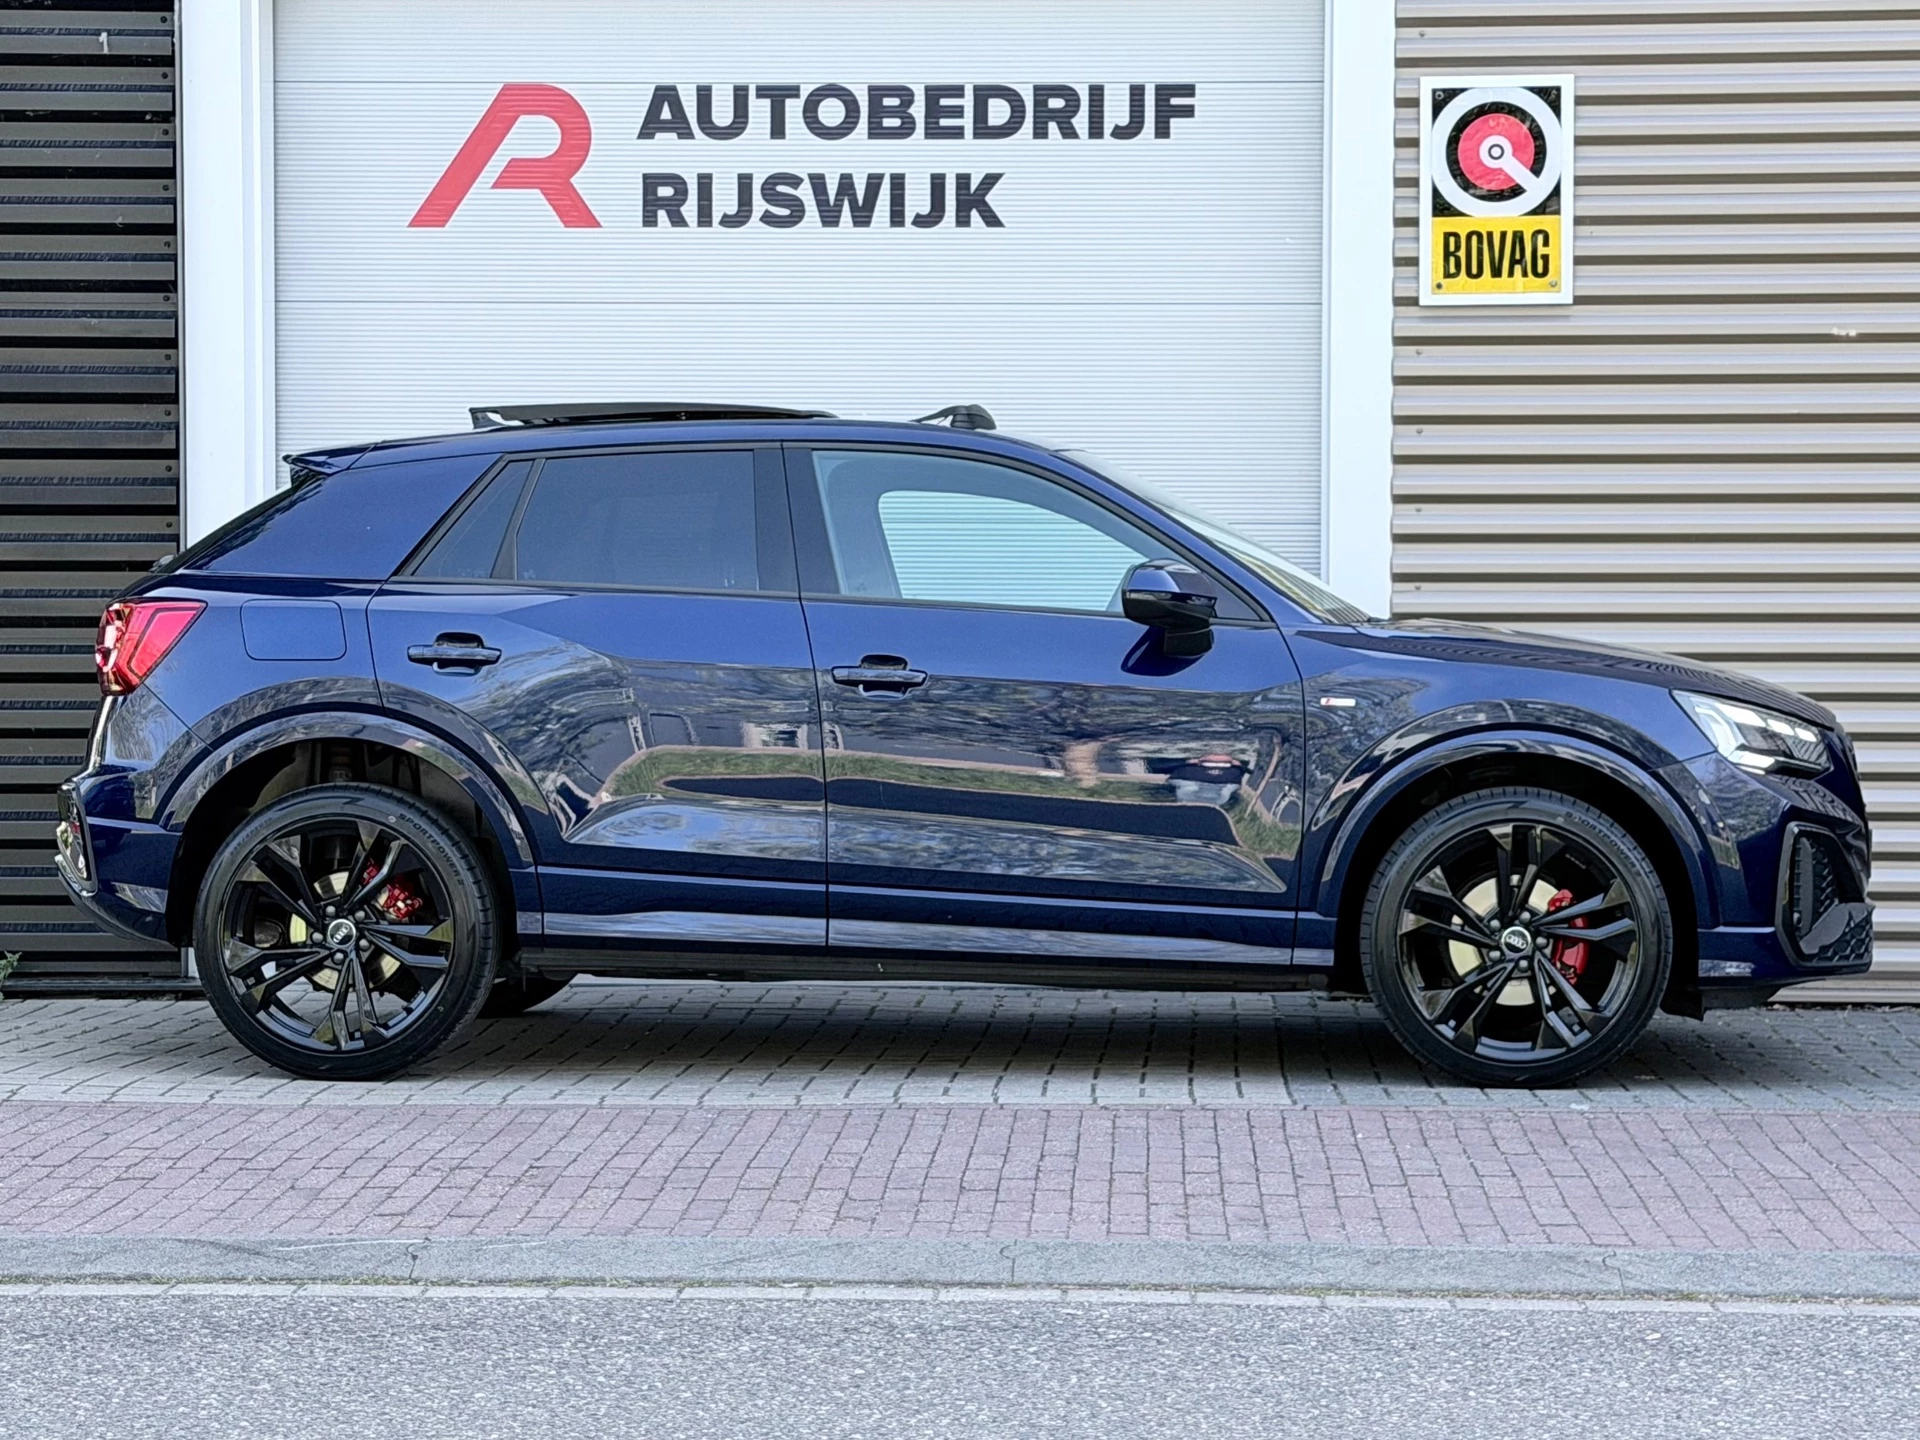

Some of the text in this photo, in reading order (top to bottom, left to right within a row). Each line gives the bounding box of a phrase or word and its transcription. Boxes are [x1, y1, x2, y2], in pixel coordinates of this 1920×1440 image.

[637, 83, 1196, 141] AUTOBEDRIJF
[642, 173, 1005, 228] RIJSWIJK
[1442, 228, 1551, 280] BOVAG
